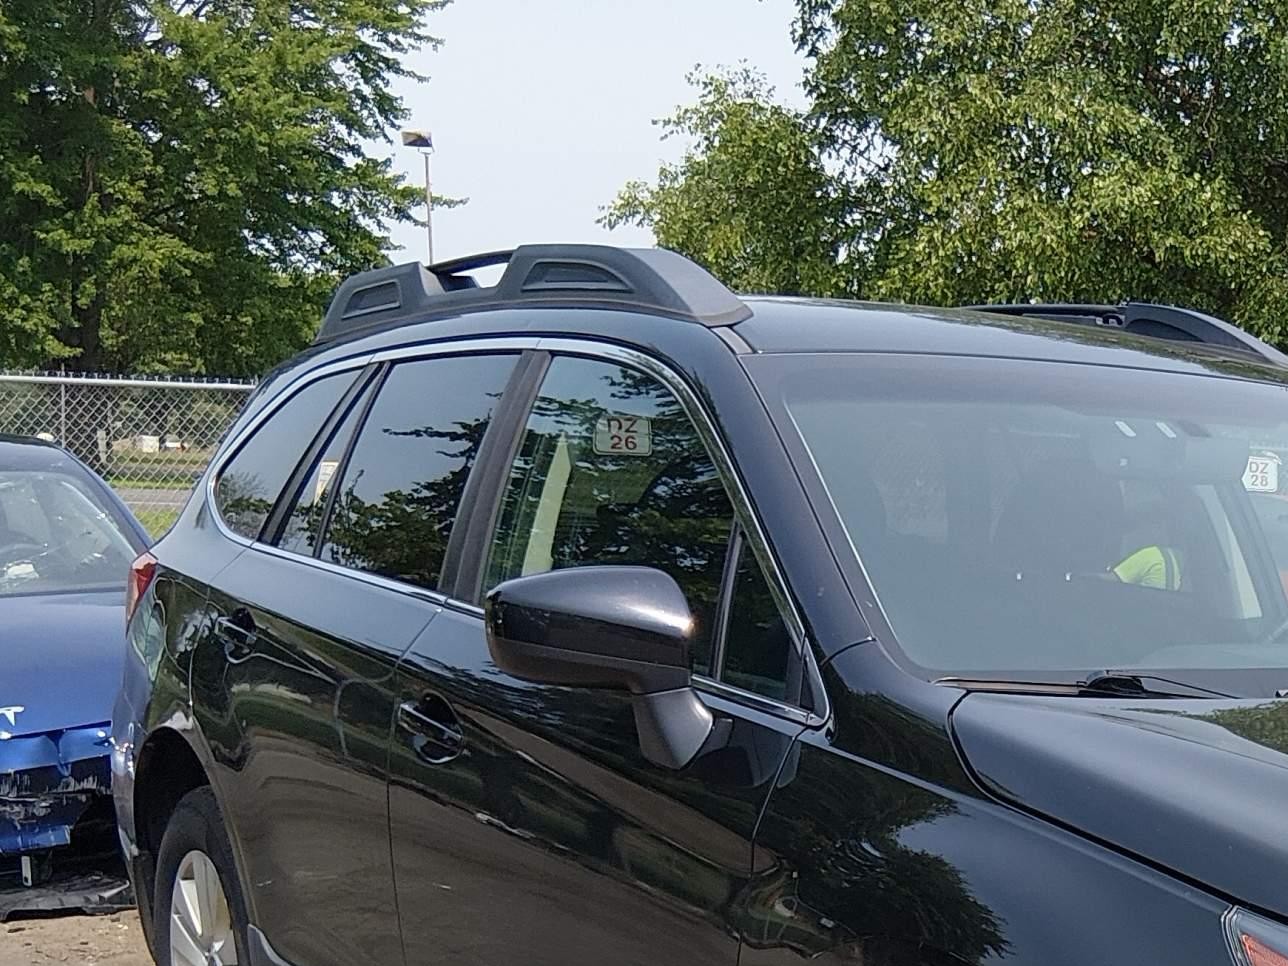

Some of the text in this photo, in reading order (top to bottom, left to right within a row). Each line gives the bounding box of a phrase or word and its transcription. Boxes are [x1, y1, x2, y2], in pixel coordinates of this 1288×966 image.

[610, 435, 637, 450] 26
[1249, 461, 1268, 474] DZ
[1251, 475, 1268, 487] 28
